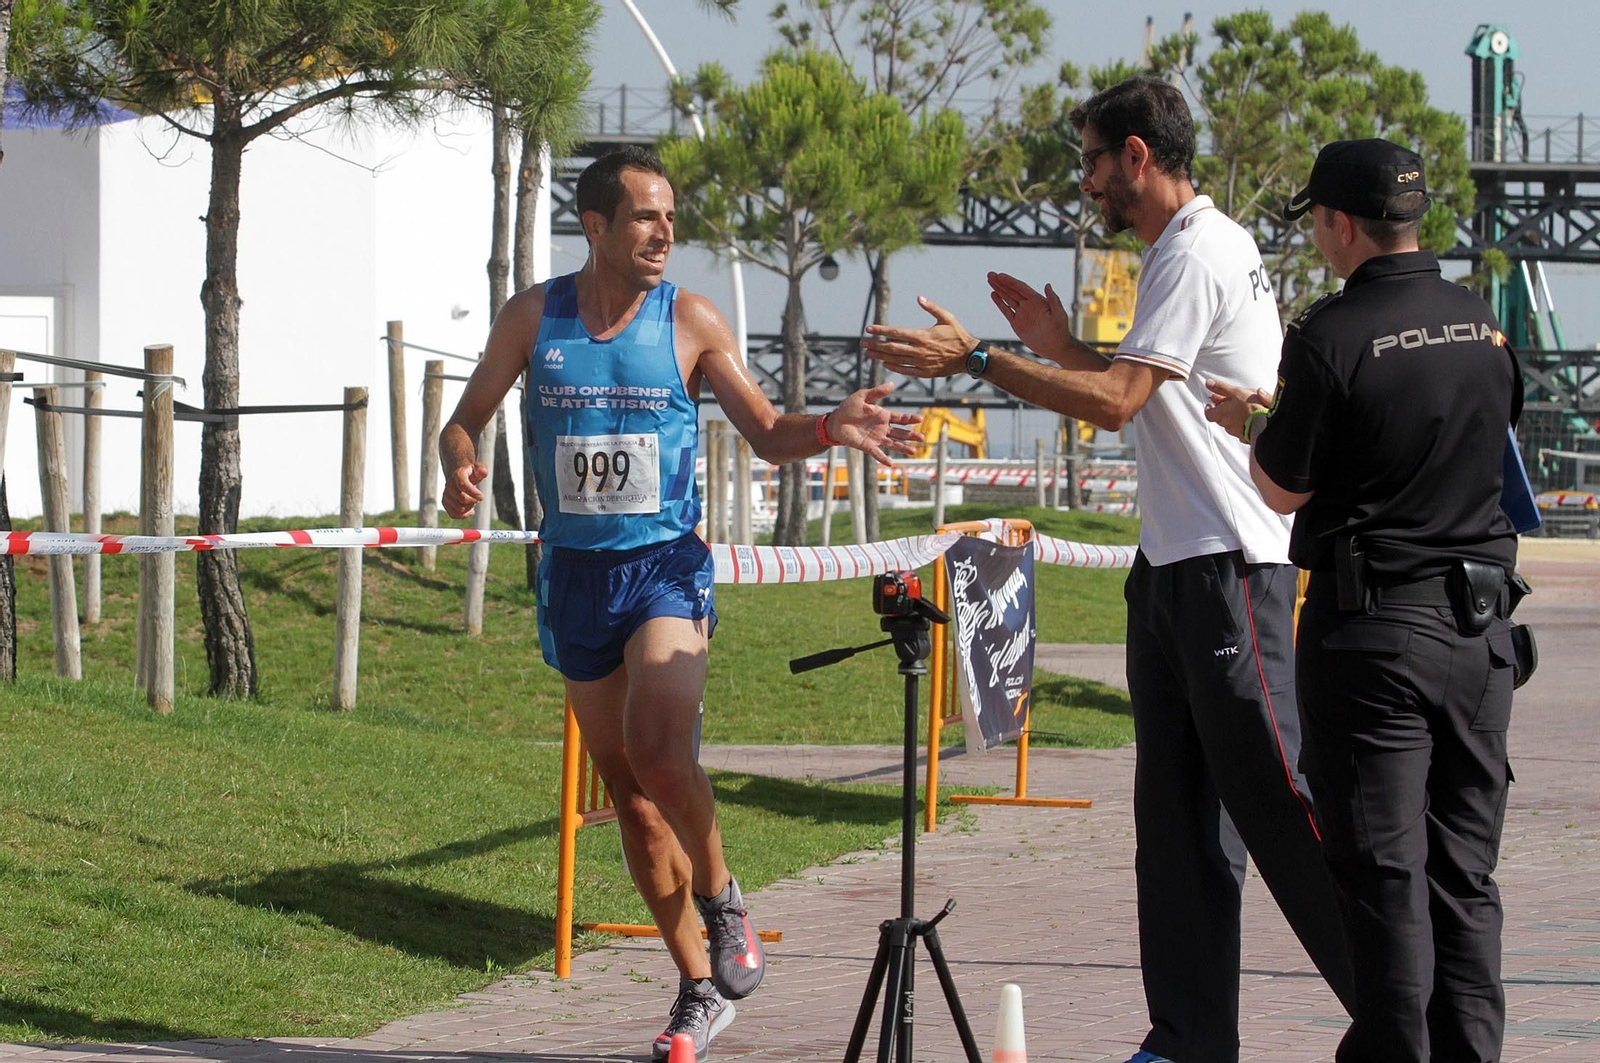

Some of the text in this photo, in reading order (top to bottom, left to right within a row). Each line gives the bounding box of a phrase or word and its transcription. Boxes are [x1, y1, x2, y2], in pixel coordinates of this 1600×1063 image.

[1397, 171, 1420, 183] CNP
[1372, 322, 1494, 358] POLICIA
[538, 384, 672, 398] CLUB ONUBENSE
[541, 396, 669, 411] DE ATLETISMO
[573, 450, 631, 493] 999
[1213, 645, 1239, 656] WTK
